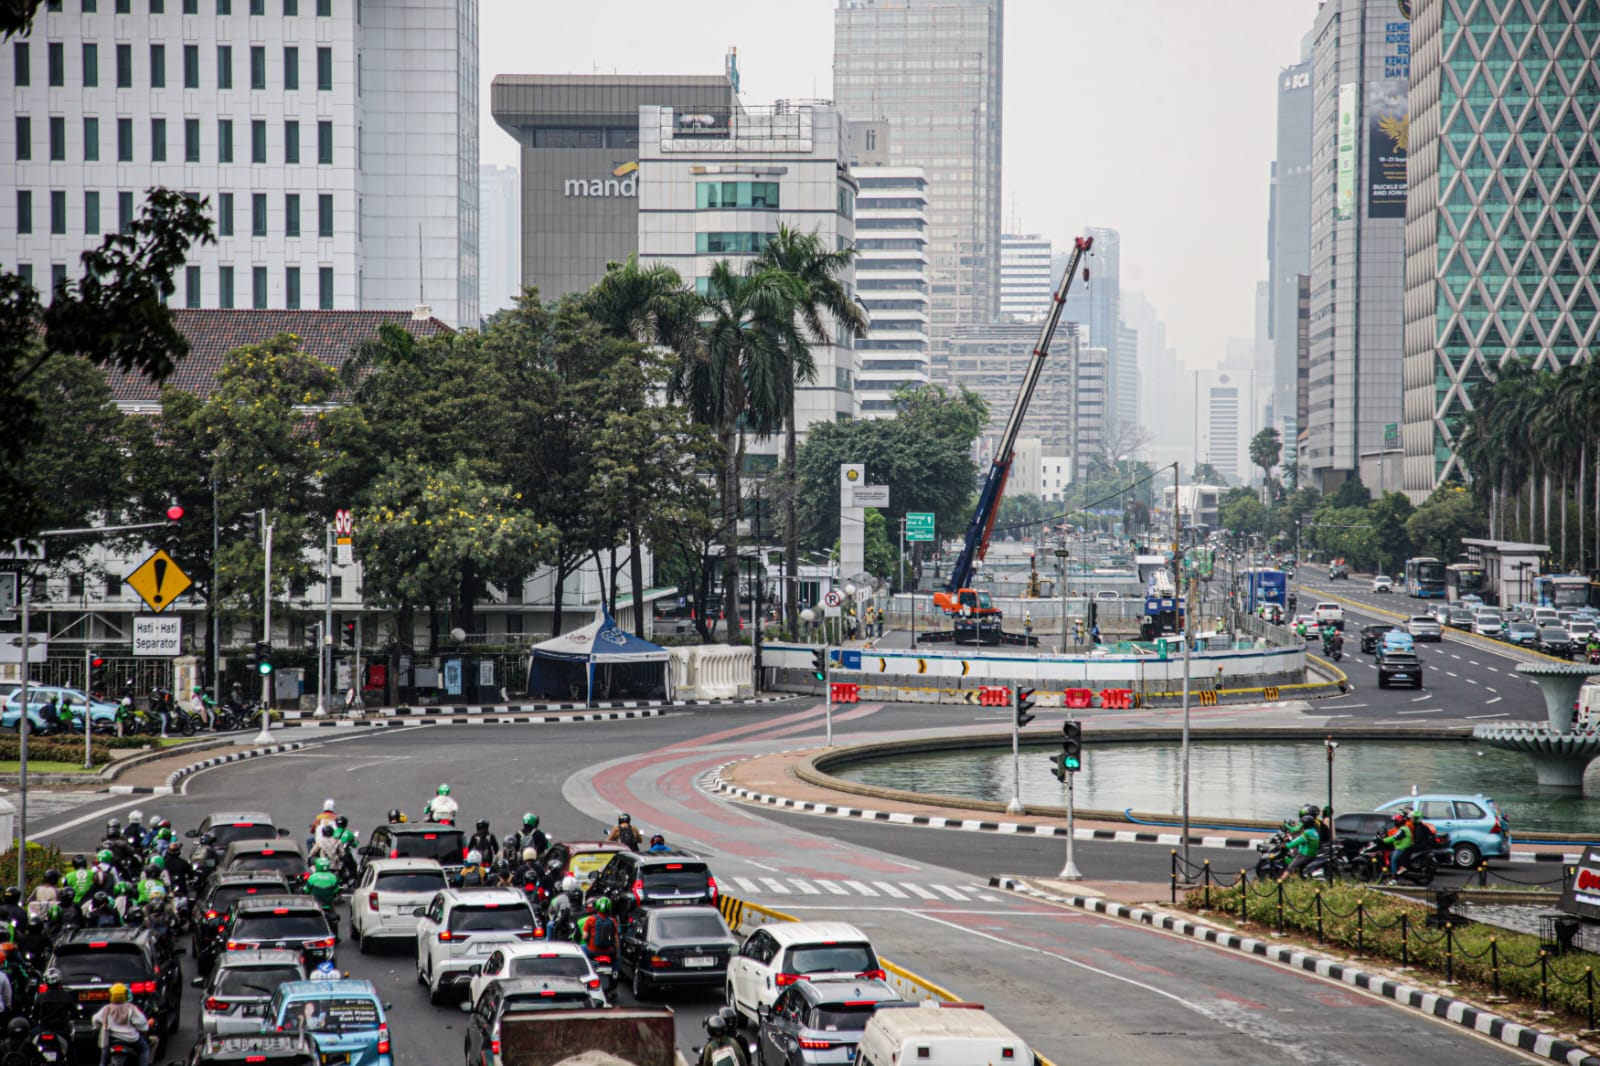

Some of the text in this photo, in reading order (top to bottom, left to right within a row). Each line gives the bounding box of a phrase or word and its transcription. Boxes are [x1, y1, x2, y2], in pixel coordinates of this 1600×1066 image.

[564, 171, 639, 197] mand
[137, 623, 153, 634] Hati
[160, 623, 177, 634] Hati
[136, 638, 177, 651] Separator
